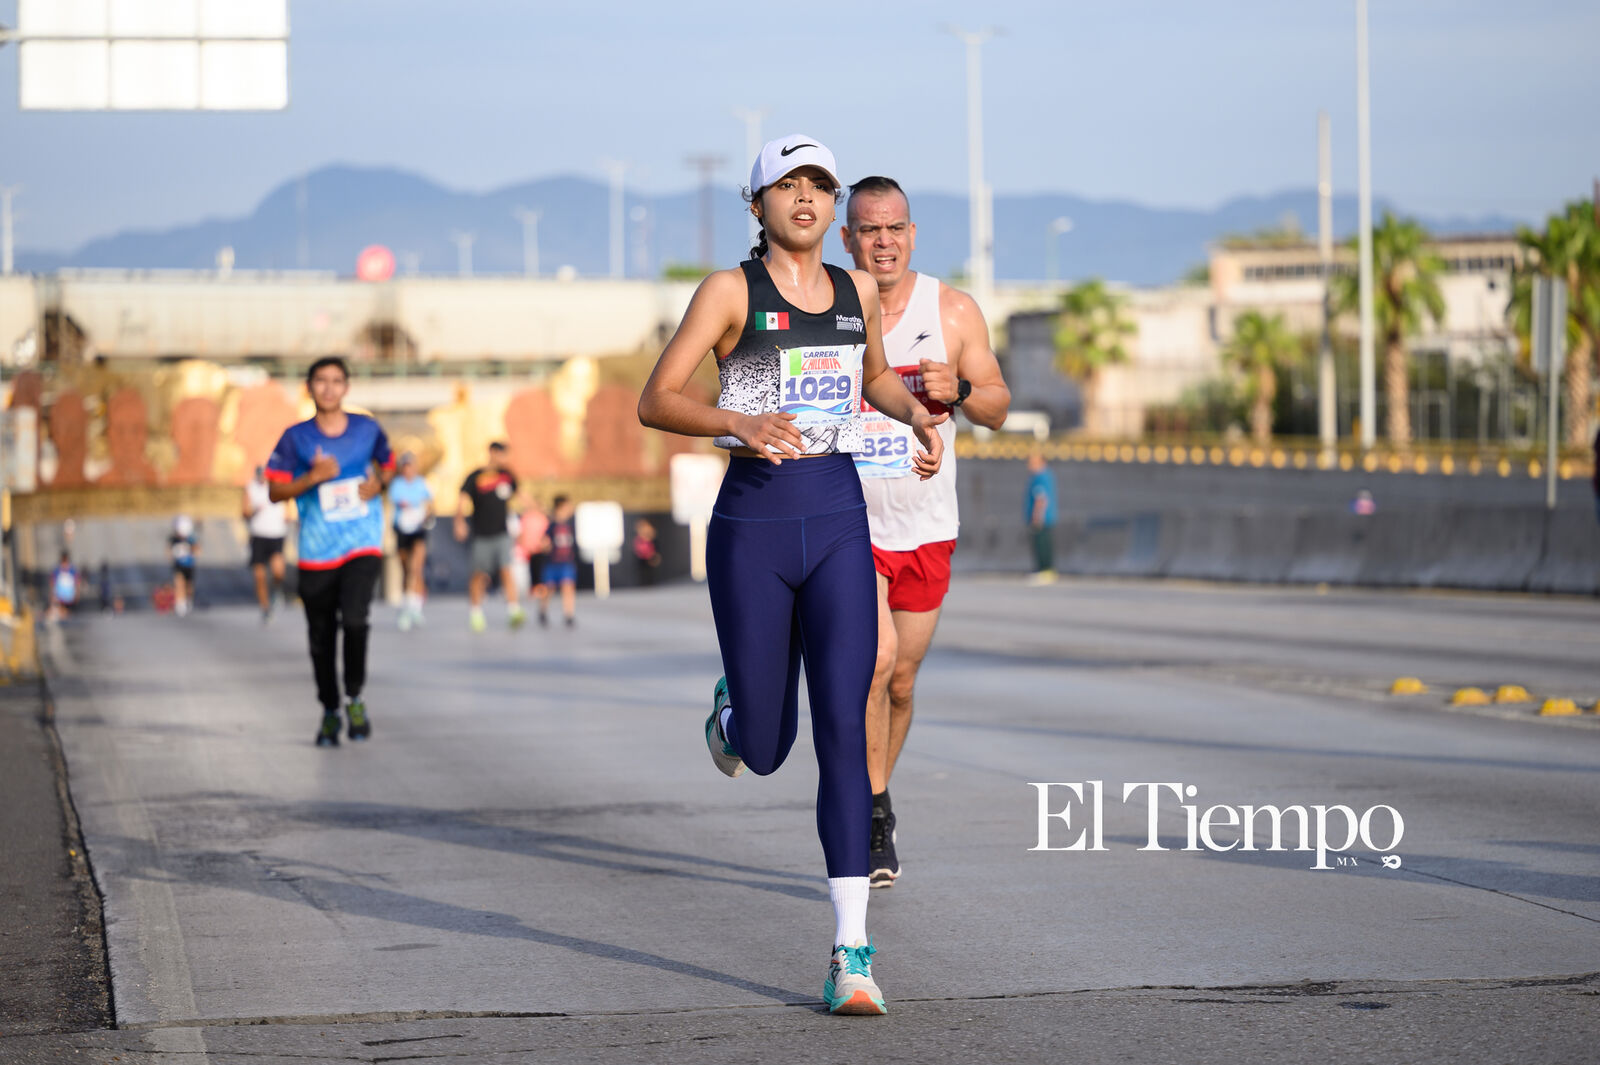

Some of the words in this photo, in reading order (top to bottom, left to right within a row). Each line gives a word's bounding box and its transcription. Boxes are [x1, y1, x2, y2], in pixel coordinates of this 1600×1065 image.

[803, 350, 839, 358] CARRERA
[785, 375, 851, 401] 1029
[852, 436, 908, 457] 823
